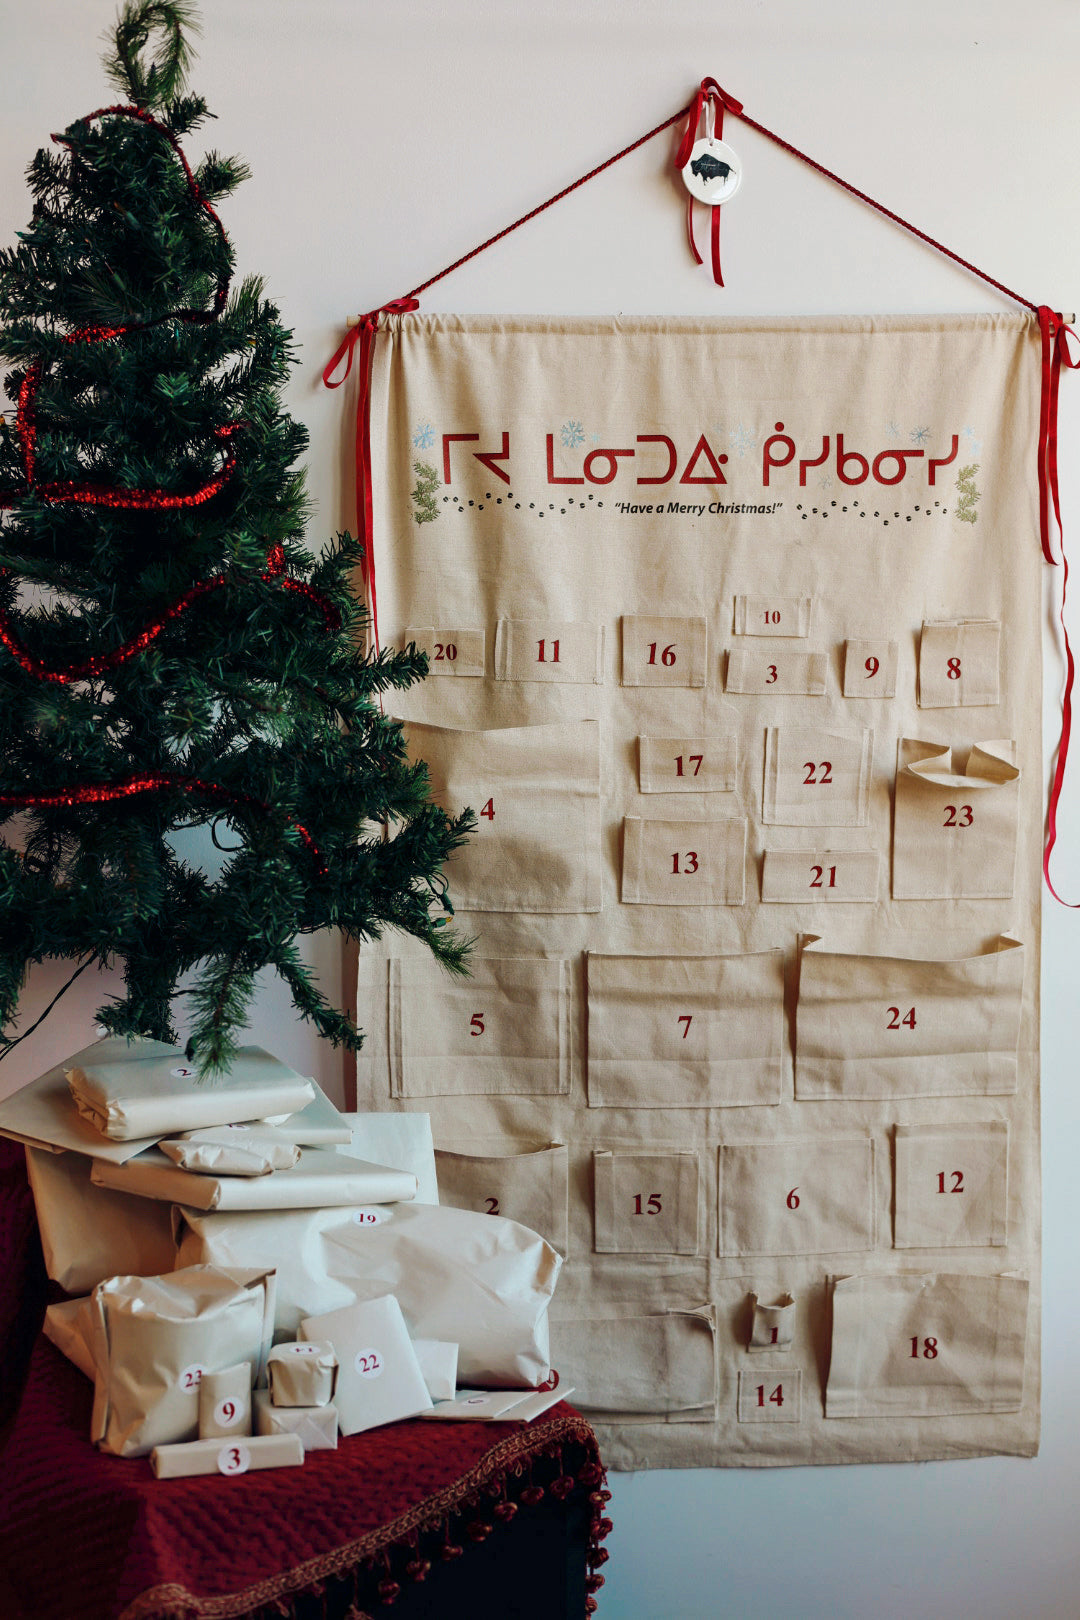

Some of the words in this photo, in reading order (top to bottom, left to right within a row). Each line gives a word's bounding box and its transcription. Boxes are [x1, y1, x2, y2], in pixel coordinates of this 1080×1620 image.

[656, 505, 664, 514] a
[667, 502, 706, 517] Merry
[765, 610, 781, 625] 10
[434, 643, 457, 661] 20
[537, 639, 560, 663] 11
[648, 643, 677, 667] 16
[766, 665, 778, 684] 3
[864, 657, 880, 678] 9
[947, 657, 961, 679] 8
[676, 754, 704, 777] 17
[803, 761, 833, 785] 22
[480, 799, 495, 821] 4
[943, 805, 974, 828] 23
[672, 851, 699, 875] 13
[810, 865, 836, 888] 21
[470, 1013, 486, 1037] 5
[678, 1015, 692, 1039] 7
[887, 1007, 917, 1030] 24
[938, 1171, 963, 1194] 12
[634, 1193, 663, 1217] 15
[785, 1188, 801, 1209] 6
[357, 1211, 378, 1226] 19
[770, 1327, 779, 1345] 1
[911, 1335, 938, 1359] 18
[359, 1353, 380, 1373] 22
[757, 1385, 784, 1407] 14
[221, 1401, 236, 1423] 9
[227, 1447, 241, 1471] 3
